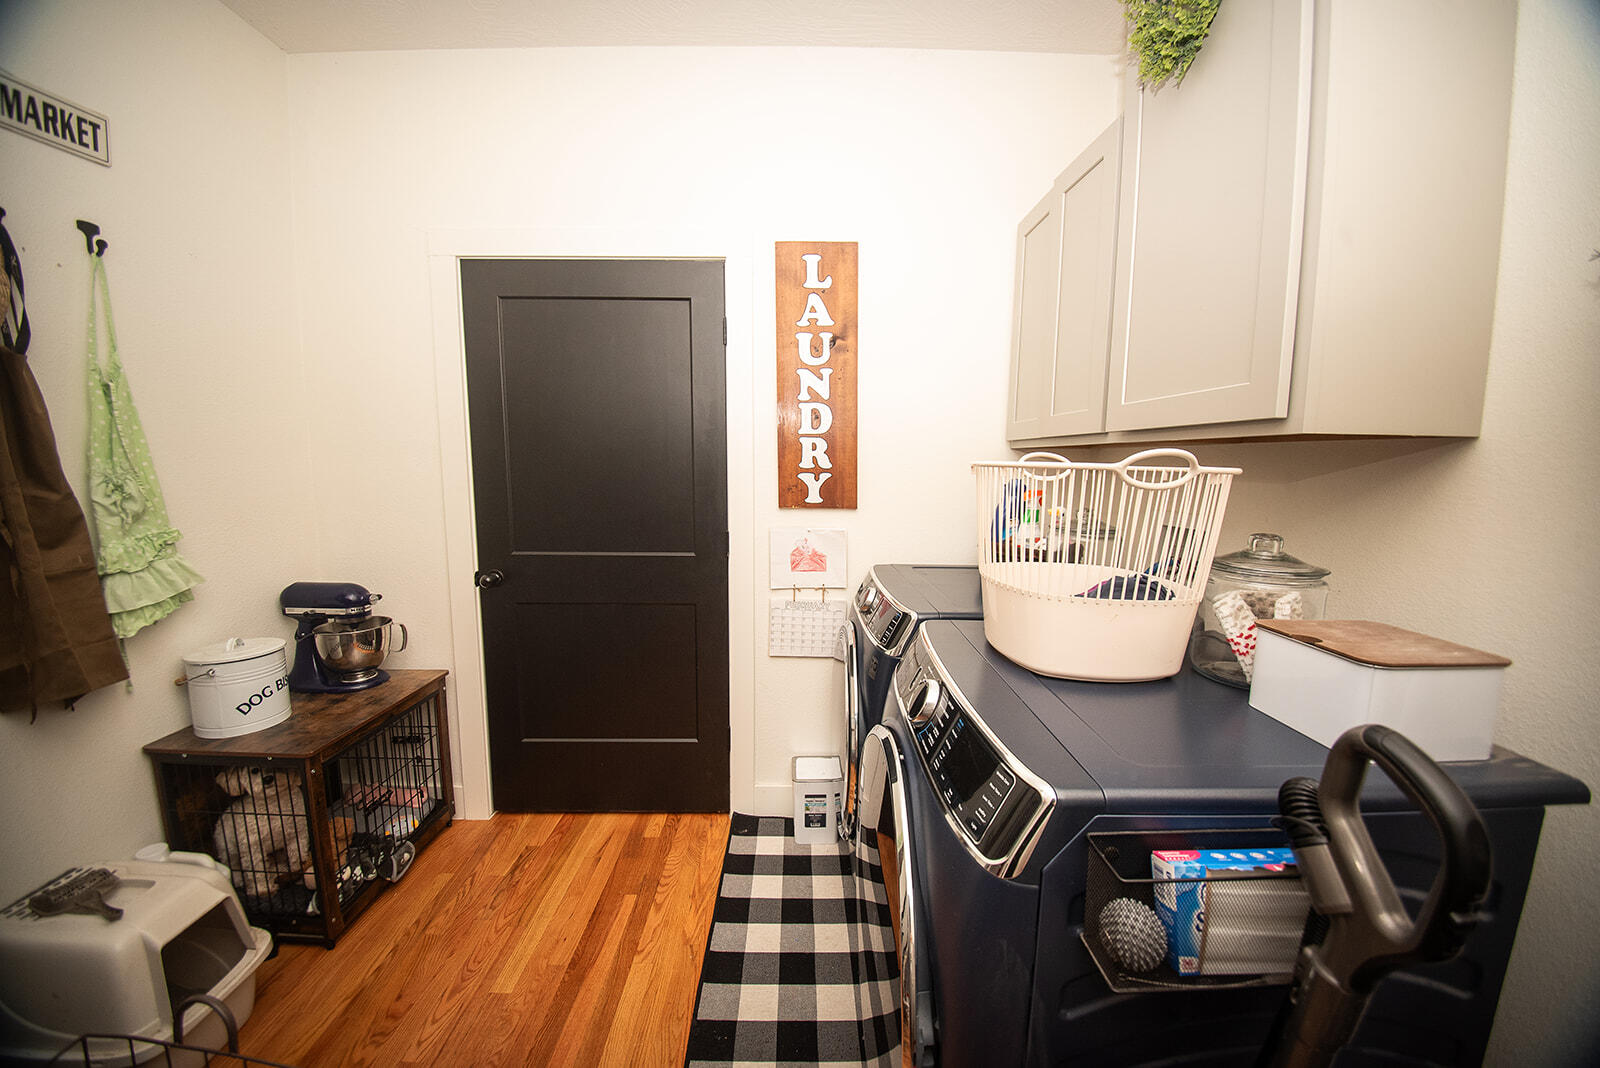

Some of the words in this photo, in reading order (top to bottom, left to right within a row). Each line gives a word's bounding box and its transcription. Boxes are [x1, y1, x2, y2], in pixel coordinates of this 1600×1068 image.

[0, 82, 101, 153] MARKET
[795, 253, 835, 504] LAUNDRY
[235, 685, 274, 716] DOG
